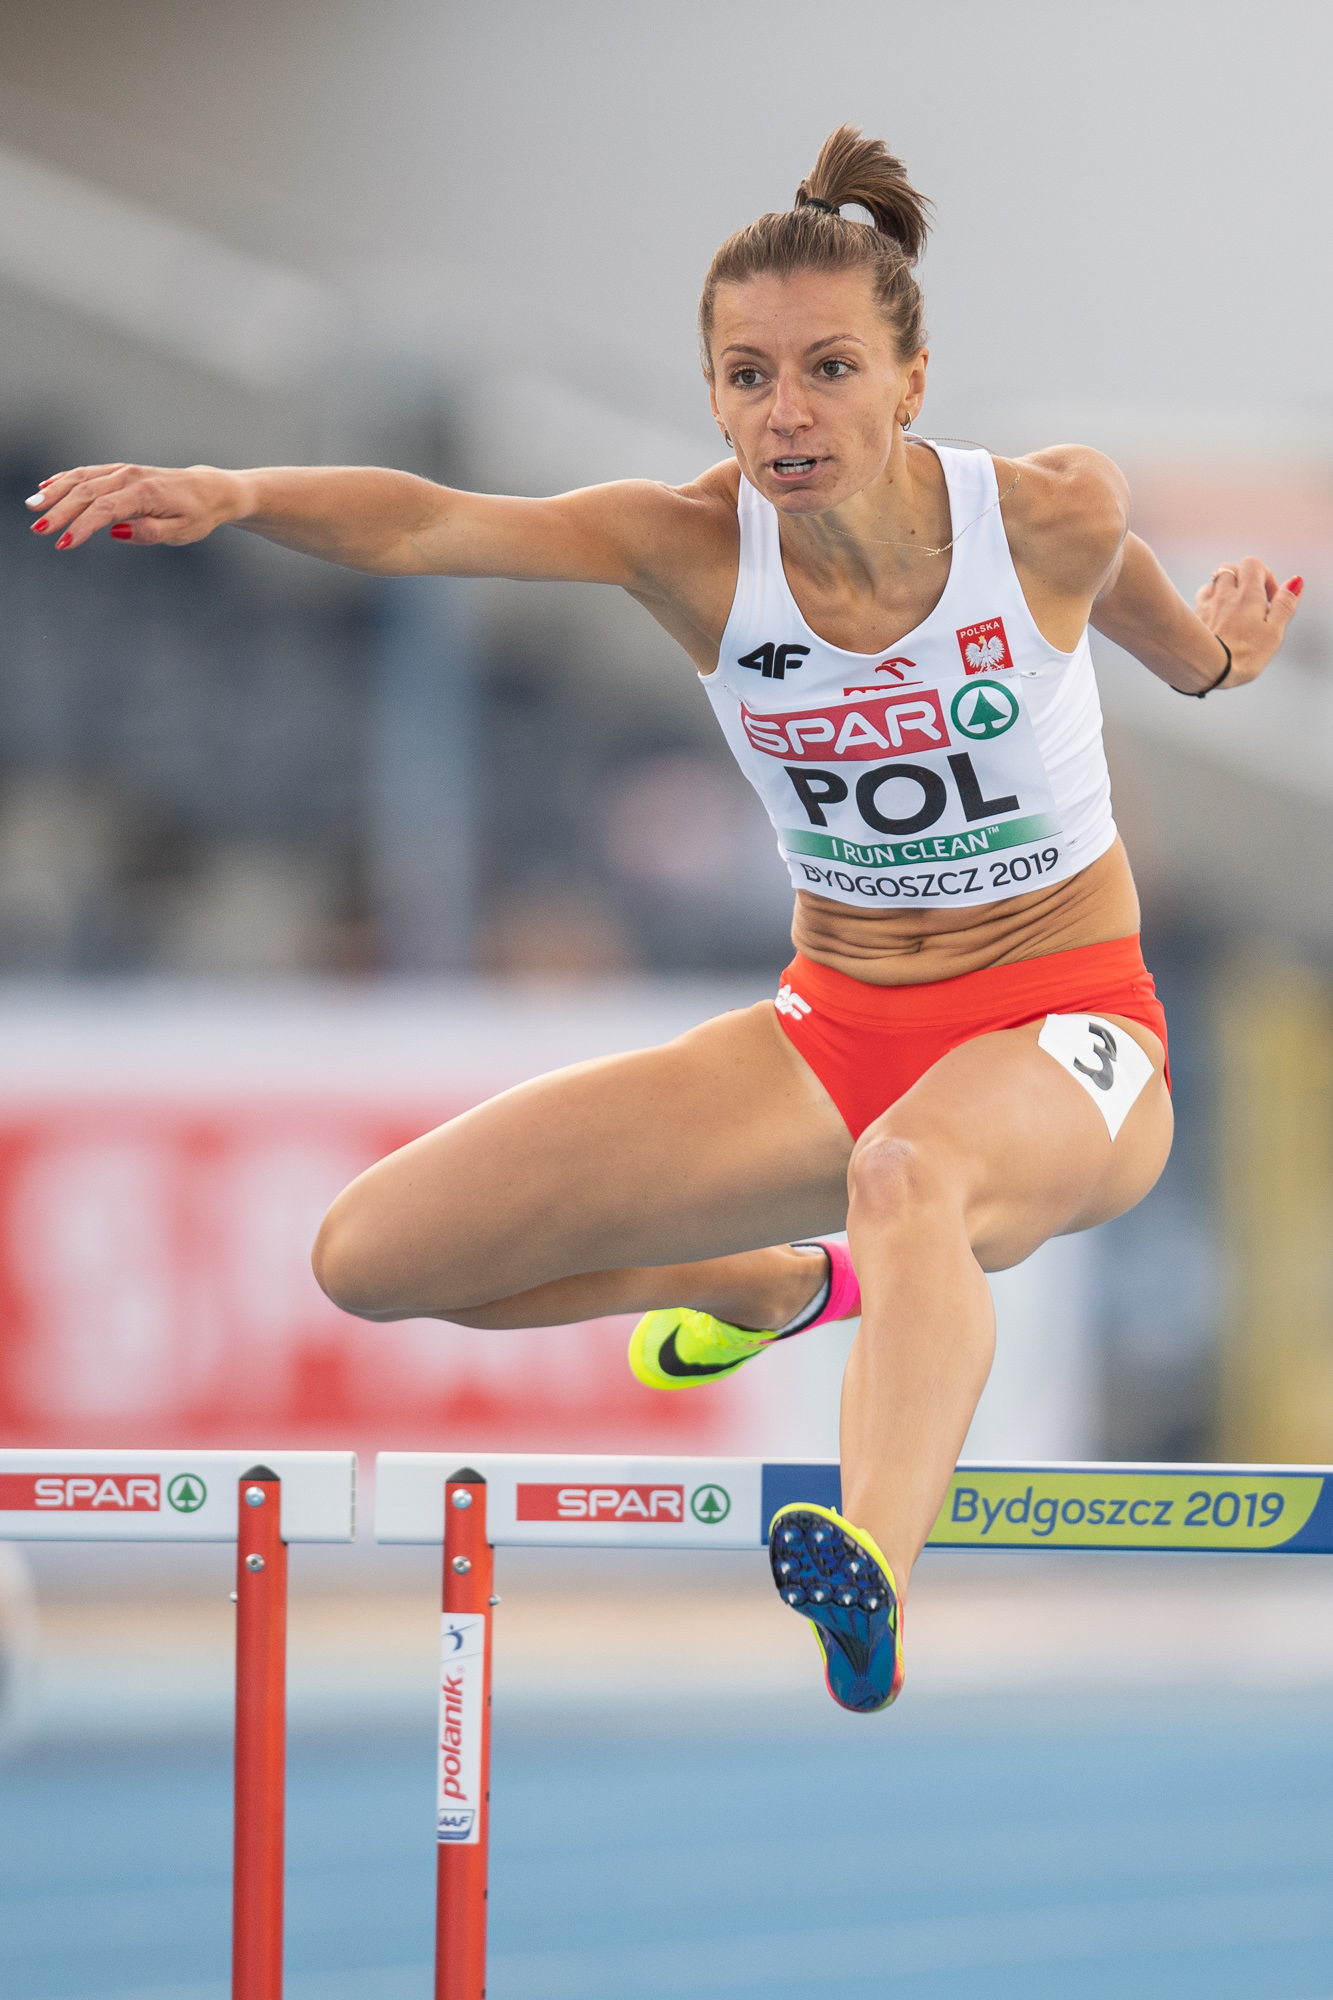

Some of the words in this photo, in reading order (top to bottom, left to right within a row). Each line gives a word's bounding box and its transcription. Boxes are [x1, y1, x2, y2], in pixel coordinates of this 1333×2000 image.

[960, 621, 1000, 639] POLSKA
[737, 641, 811, 680] 4F
[744, 700, 942, 755] SPAR
[783, 752, 1020, 835] POL
[831, 839, 838, 857] I
[842, 842, 896, 865] RUN
[799, 862, 984, 898] BYDGOSZCZ
[989, 847, 1059, 887] 2019
[1073, 1022, 1117, 1091] 3
[34, 1478, 158, 1507] SPAR
[557, 1488, 681, 1518] SPAR
[951, 1486, 1174, 1537] Bydgoszcz
[1183, 1491, 1285, 1528] 2019
[438, 1815, 470, 1827] AAF
